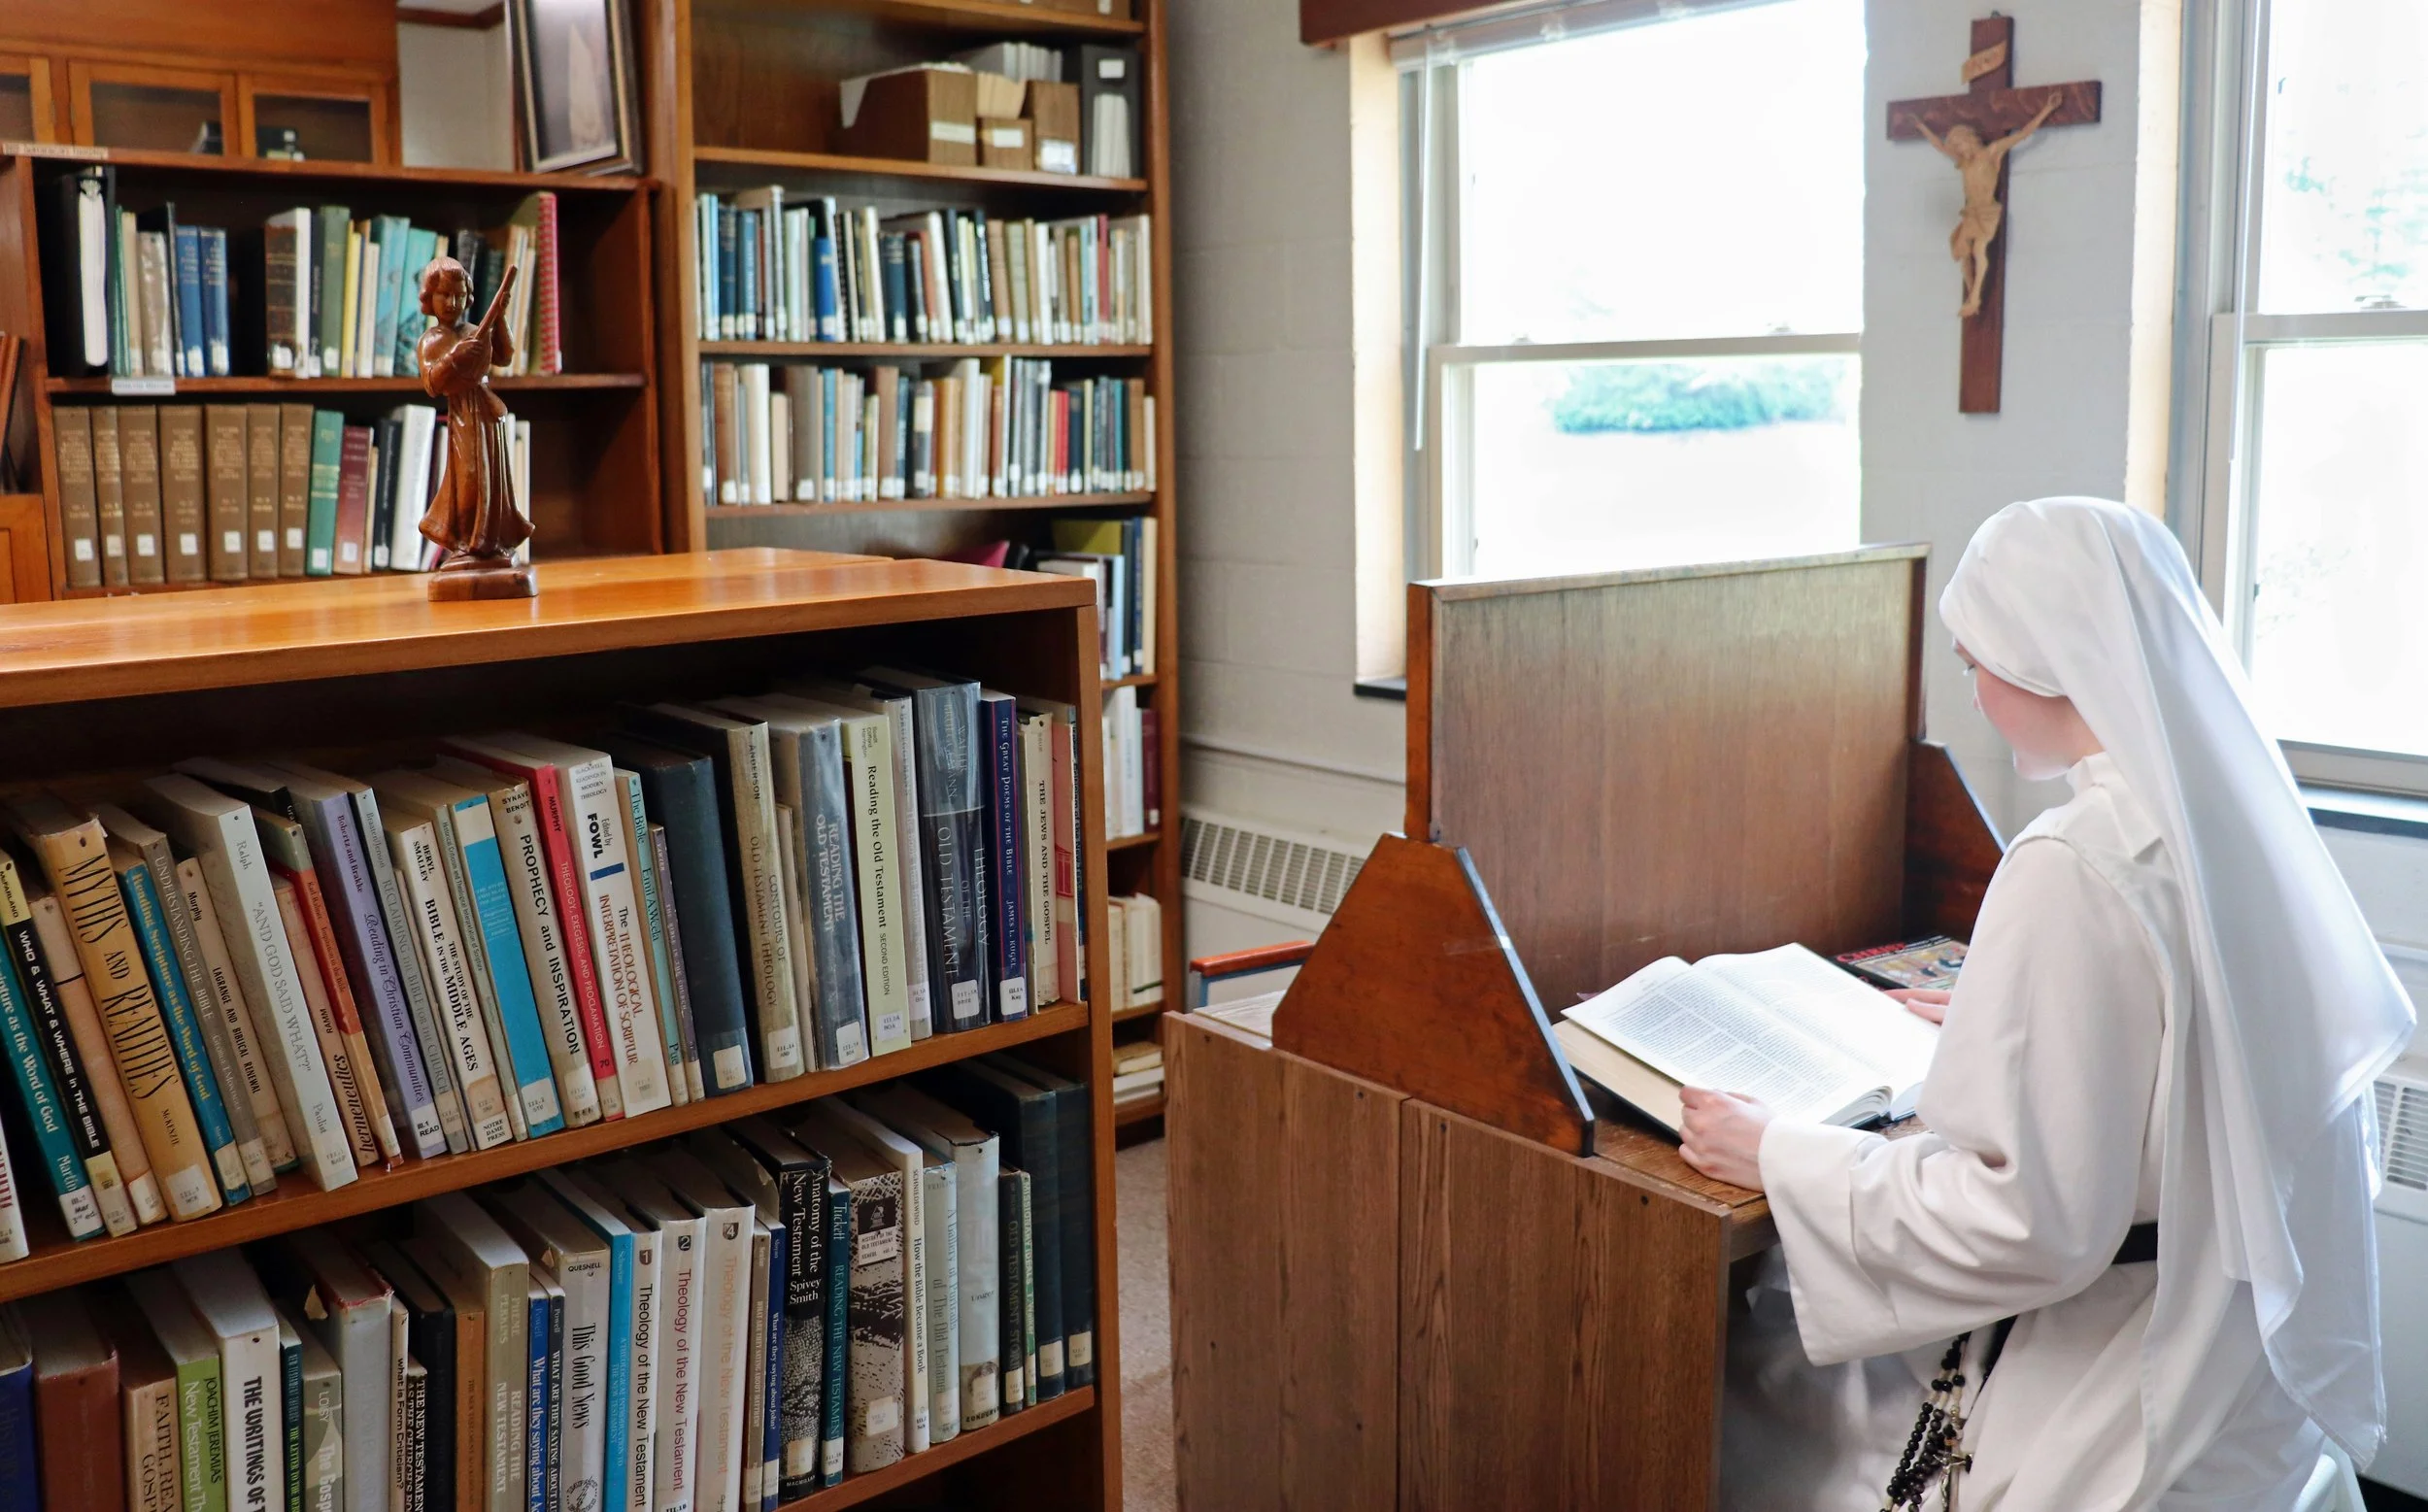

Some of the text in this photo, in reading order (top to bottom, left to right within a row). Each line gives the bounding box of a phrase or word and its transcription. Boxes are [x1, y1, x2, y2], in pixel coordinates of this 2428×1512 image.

[502, 790, 529, 805] SYNAVE
[749, 745, 760, 800] ANDERSON
[506, 800, 530, 814] BENOIT
[548, 795, 562, 832] MURPHY
[631, 791, 647, 845] The Bible
[236, 840, 253, 871] Ralph
[337, 815, 363, 893] Bobertz and Brakke
[587, 813, 604, 859] FOWL
[601, 818, 614, 847] Edited by
[868, 765, 888, 928] Reading the Old Testament
[413, 841, 429, 883] SMALLEY
[422, 843, 437, 875] BERYL
[520, 834, 551, 917] PROPHECY
[816, 814, 835, 932] OLD TESTAMENT
[827, 823, 846, 922] READING THE
[58, 853, 129, 944] MYTHS
[187, 891, 203, 922] Murphy
[750, 836, 778, 1006] OLD TESTAMENT THEOLOGY
[768, 875, 787, 962] CONTOURS OF
[937, 826, 960, 976] OLD TESTAMENT
[961, 881, 971, 919] OF THE
[974, 848, 990, 946] THEOLOGY
[154, 857, 215, 1020] UNDERSTANDING THE BIBLE
[541, 924, 556, 952] and
[619, 905, 645, 1018] The THEOLOGICAL
[103, 950, 130, 980] AND
[424, 898, 480, 1073] BIBLE IN THE MIDDLE AGES
[448, 941, 475, 1022] THE STUDY OF THE
[882, 964, 891, 995] EDITION
[213, 967, 261, 1094] LAGRANGE AND BIBLICAL RENEWAL
[320, 1008, 334, 1034] RAMM
[364, 913, 426, 1103] Reading in Christian Communities
[548, 957, 581, 1056] INSPIRATION
[18, 930, 100, 1149] WHO & WHAT & WHERE in THE BIBLE
[101, 983, 179, 1099] REALITIES
[599, 1059, 610, 1068] 70
[312, 1102, 328, 1135] Paulist
[334, 1054, 376, 1155] hermeneutics
[484, 1119, 503, 1130] NOTRE
[420, 1125, 441, 1137] READ
[486, 1126, 503, 1136] DAME
[488, 1132, 506, 1142] PRESS
[809, 1170, 826, 1273] Anatomy of the
[832, 1200, 848, 1241] Tuckett
[912, 1168, 921, 1226] SCHNIEDEWIND
[1023, 1183, 1032, 1244] MISSIONARY
[679, 1236, 691, 1250] 2
[725, 1226, 735, 1237] 4
[792, 1170, 807, 1278] New Testament
[913, 1237, 922, 1261] How
[568, 1262, 602, 1273] QUESNELL
[642, 1251, 649, 1263] 1
[914, 1261, 924, 1279] the
[1025, 1247, 1033, 1284] IDEALS
[790, 1277, 823, 1293] Spivey
[790, 1290, 820, 1306] Smith
[915, 1279, 926, 1302] Bible
[511, 1296, 522, 1337] PHEME
[915, 1303, 927, 1339] Became
[571, 1323, 596, 1429] This Good News
[672, 1268, 691, 1492] Theology of the New Testament
[717, 1255, 737, 1475] Theology of the New Testament
[916, 1349, 927, 1375] Book
[319, 1391, 330, 1423] LOISY
[634, 1283, 654, 1507] Theology of the New Testament
[204, 1377, 222, 1485] JOACHIM JEREMIAS
[244, 1376, 266, 1504] THE WRITINGS OF
[496, 1382, 508, 1494] NEW TESTAMENT
[510, 1390, 523, 1484] READING THE
[529, 1356, 546, 1497] What are they saying about
[549, 1350, 561, 1498] WHAT ARE THEY SAYING ABOUT
[787, 1474, 816, 1487] MACMILLAN
